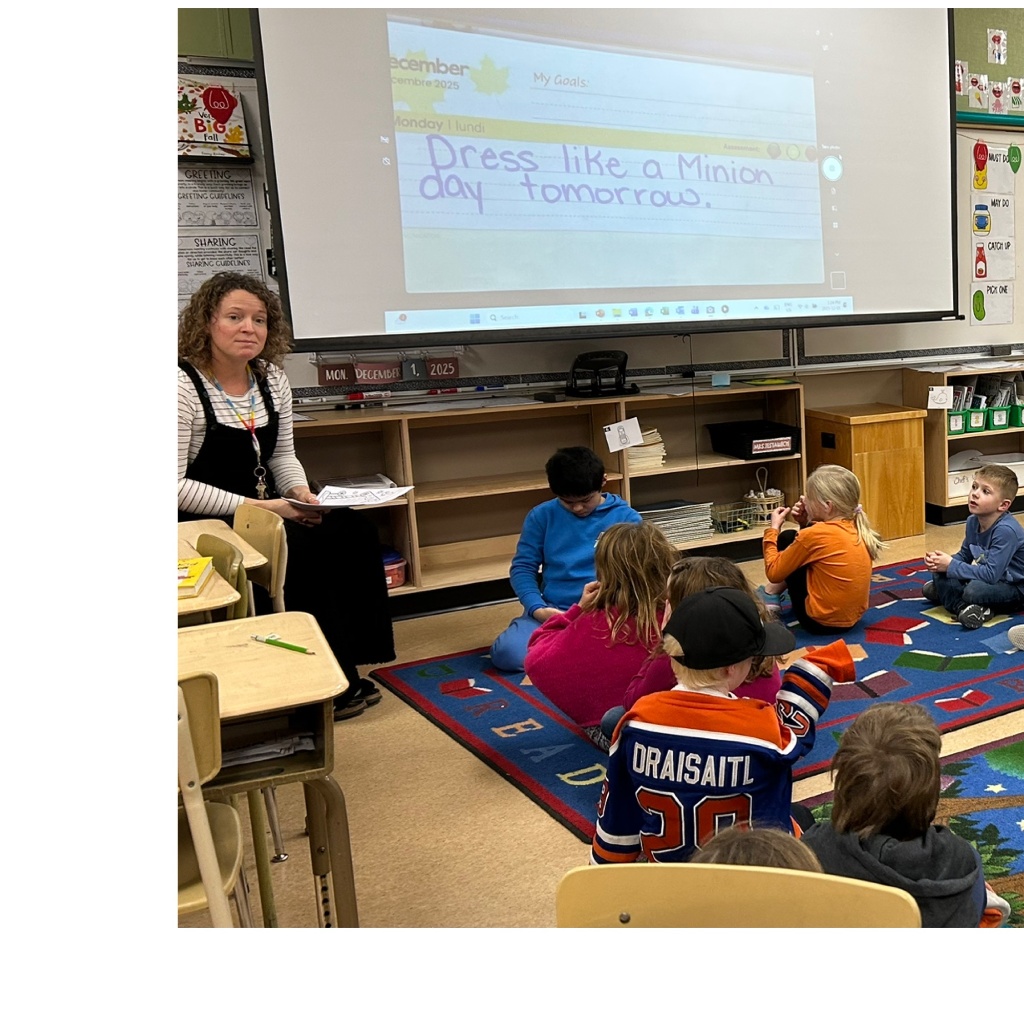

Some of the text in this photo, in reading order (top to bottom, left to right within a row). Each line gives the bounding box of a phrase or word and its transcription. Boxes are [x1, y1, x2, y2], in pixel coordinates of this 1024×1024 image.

[433, 79, 460, 90] 2025
[533, 72, 589, 89] My Goals:
[455, 118, 486, 134] lundi
[426, 134, 774, 185] Dress like a Minion
[989, 152, 1010, 164] MUST DO
[184, 169, 232, 180] GREETING
[419, 168, 712, 215] day tomorrow.
[990, 198, 1010, 208] MAY DO
[193, 237, 237, 248] SHARING
[987, 241, 1011, 251] CATCH UP
[185, 260, 215, 268] SHARING
[986, 285, 1008, 294] PICK ONE
[325, 369, 349, 382] MON.
[355, 366, 401, 381] DECEMBER
[409, 363, 420, 377] 1,
[430, 362, 456, 377] 2025
[632, 741, 755, 788] DRAISAITL
